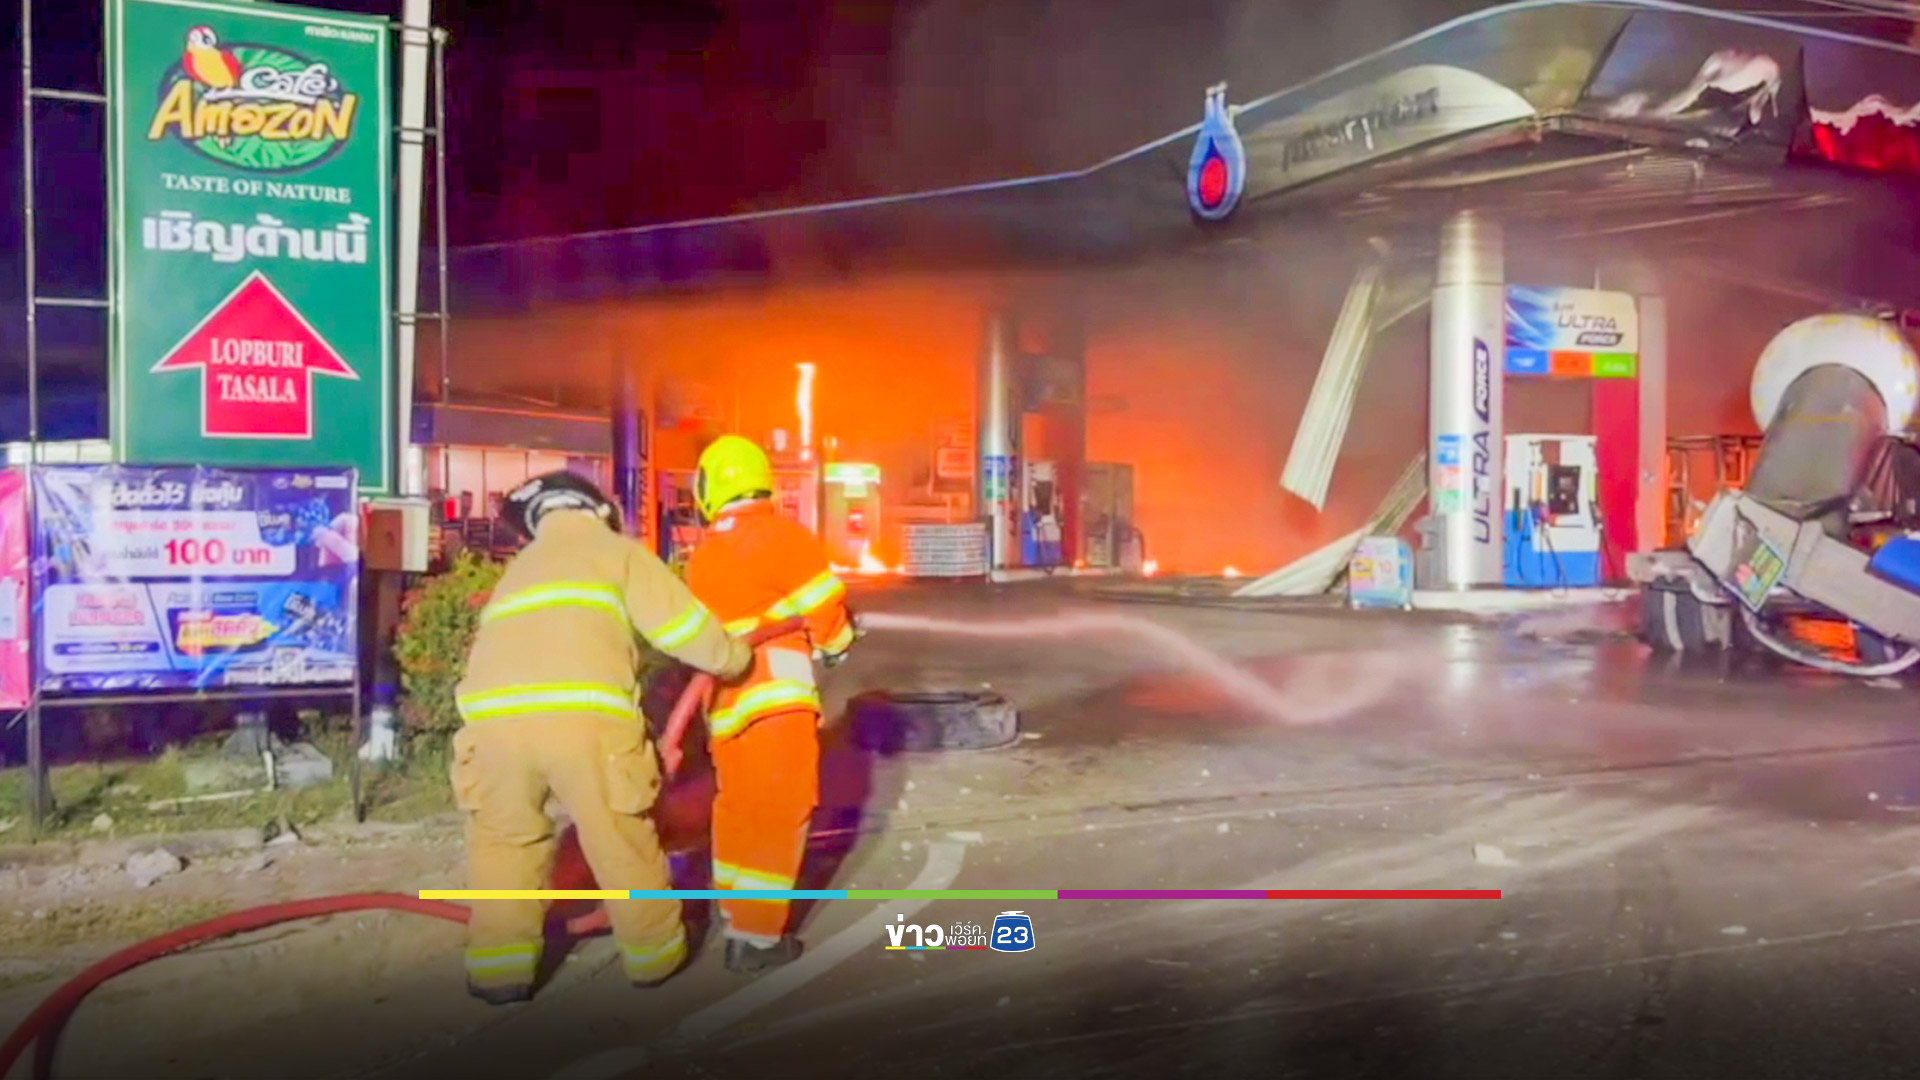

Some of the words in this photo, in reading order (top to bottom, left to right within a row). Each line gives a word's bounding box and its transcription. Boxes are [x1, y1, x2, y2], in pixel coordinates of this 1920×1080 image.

[161, 172, 230, 194] TASTE
[233, 178, 262, 197] OF
[266, 182, 351, 203] NATURE
[143, 210, 370, 263] เชิญด้านนี้
[1557, 314, 1618, 330] ULTRA
[210, 338, 304, 368] LOPBURI
[217, 374, 297, 403] TASALA
[1474, 430, 1490, 544] ULTRA
[165, 539, 227, 565] 100
[232, 548, 270, 565] บาท
